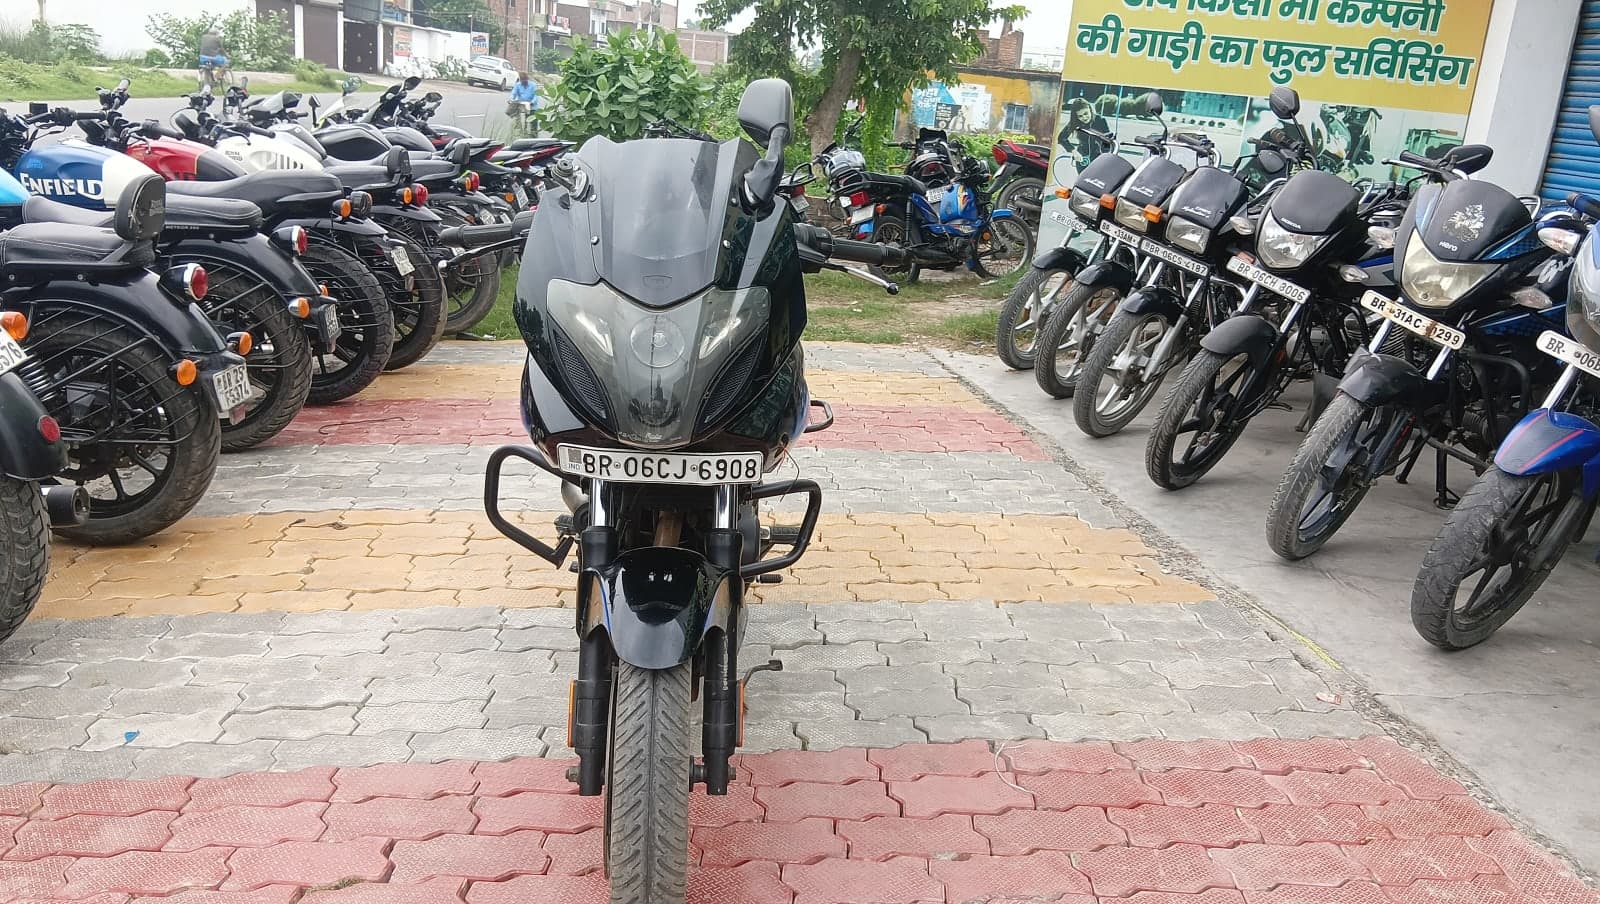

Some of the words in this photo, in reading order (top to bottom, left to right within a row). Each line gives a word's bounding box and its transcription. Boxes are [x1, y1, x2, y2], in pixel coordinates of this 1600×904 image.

[1076, 14, 1124, 54] की
[1127, 21, 1206, 69] गाड़ी
[1209, 35, 1258, 65] का
[1262, 40, 1332, 84] फुल
[1333, 38, 1474, 85] सर्विसिंग
[20, 173, 104, 200] ENFIELD
[1237, 262, 1251, 276] BR
[582, 452, 613, 476] BR
[623, 456, 687, 479] 06CJ
[699, 458, 757, 480] 6908
